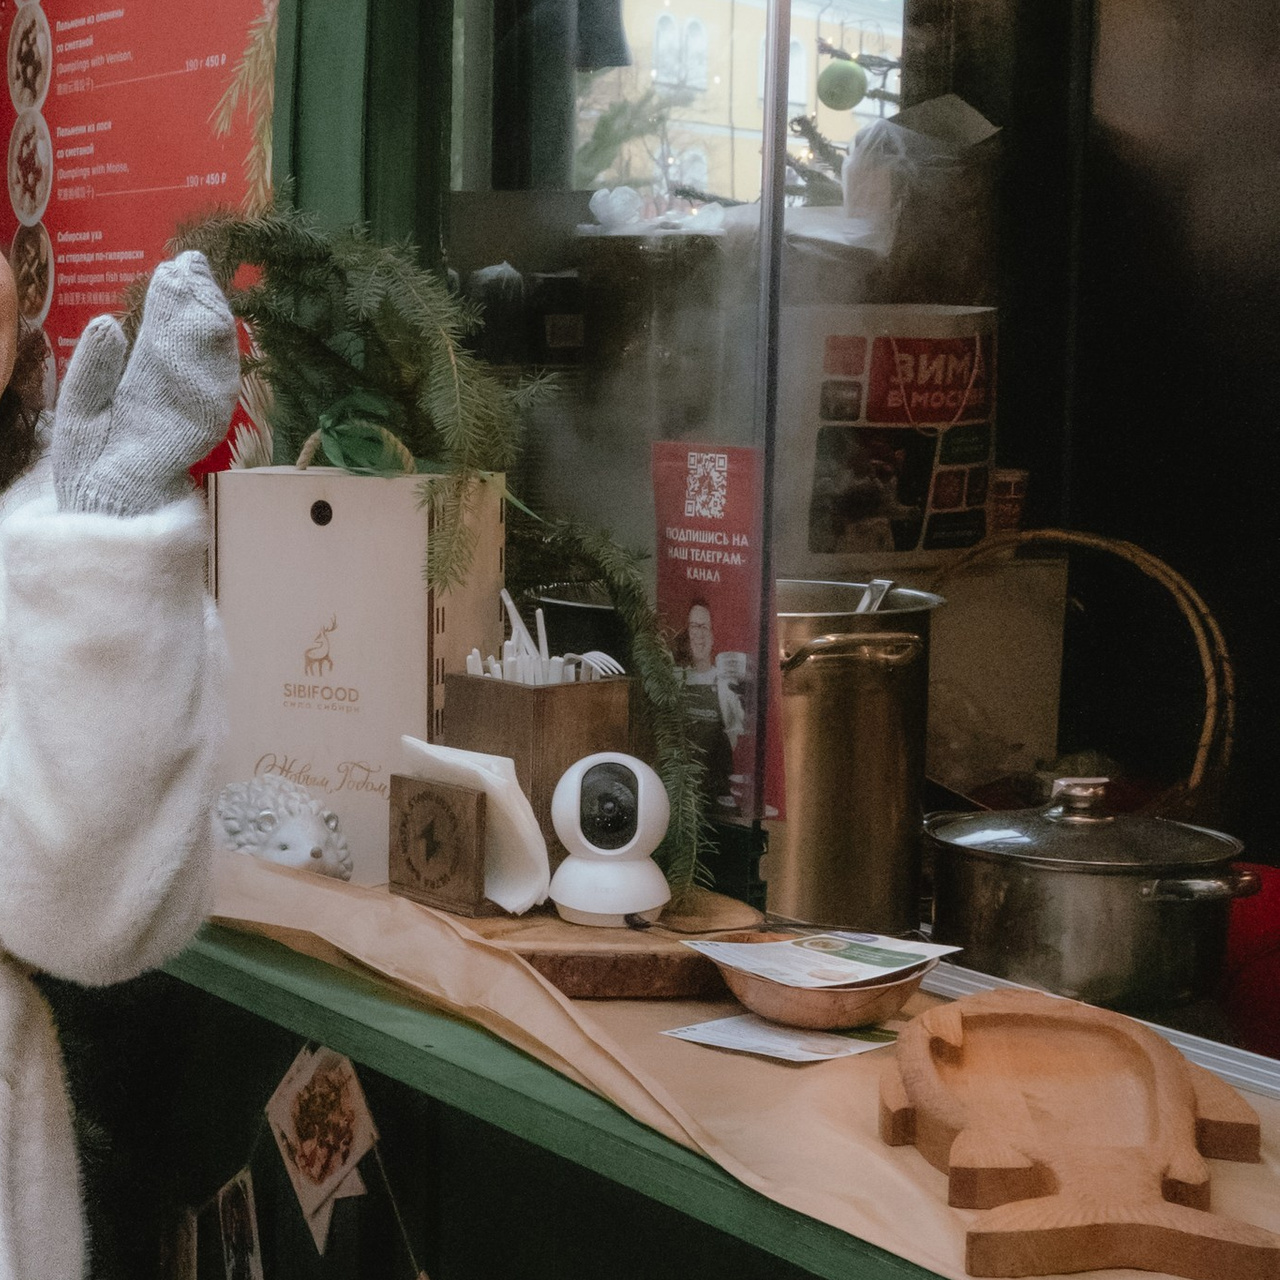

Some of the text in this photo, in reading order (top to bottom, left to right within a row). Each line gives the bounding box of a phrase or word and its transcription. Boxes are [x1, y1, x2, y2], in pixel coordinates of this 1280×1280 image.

[64, 35, 93, 51] сметаной
[91, 55, 105, 67] with
[185, 58, 198, 72] 190
[205, 55, 219, 67] 450
[65, 143, 94, 157] сметаной
[91, 164, 105, 175] with
[186, 175, 199, 187] 190
[205, 173, 219, 185] 450
[105, 271, 118, 282] fish
[910, 390, 986, 409] МОС
[665, 526, 749, 547] ПОДПИШИСЬ НА
[667, 545, 746, 565] НАШ ТЕЛЕГРАМ-
[686, 566, 721, 583] КАНАЛ
[283, 682, 360, 703] SIBIFOOD
[317, 700, 361, 714] сибири
